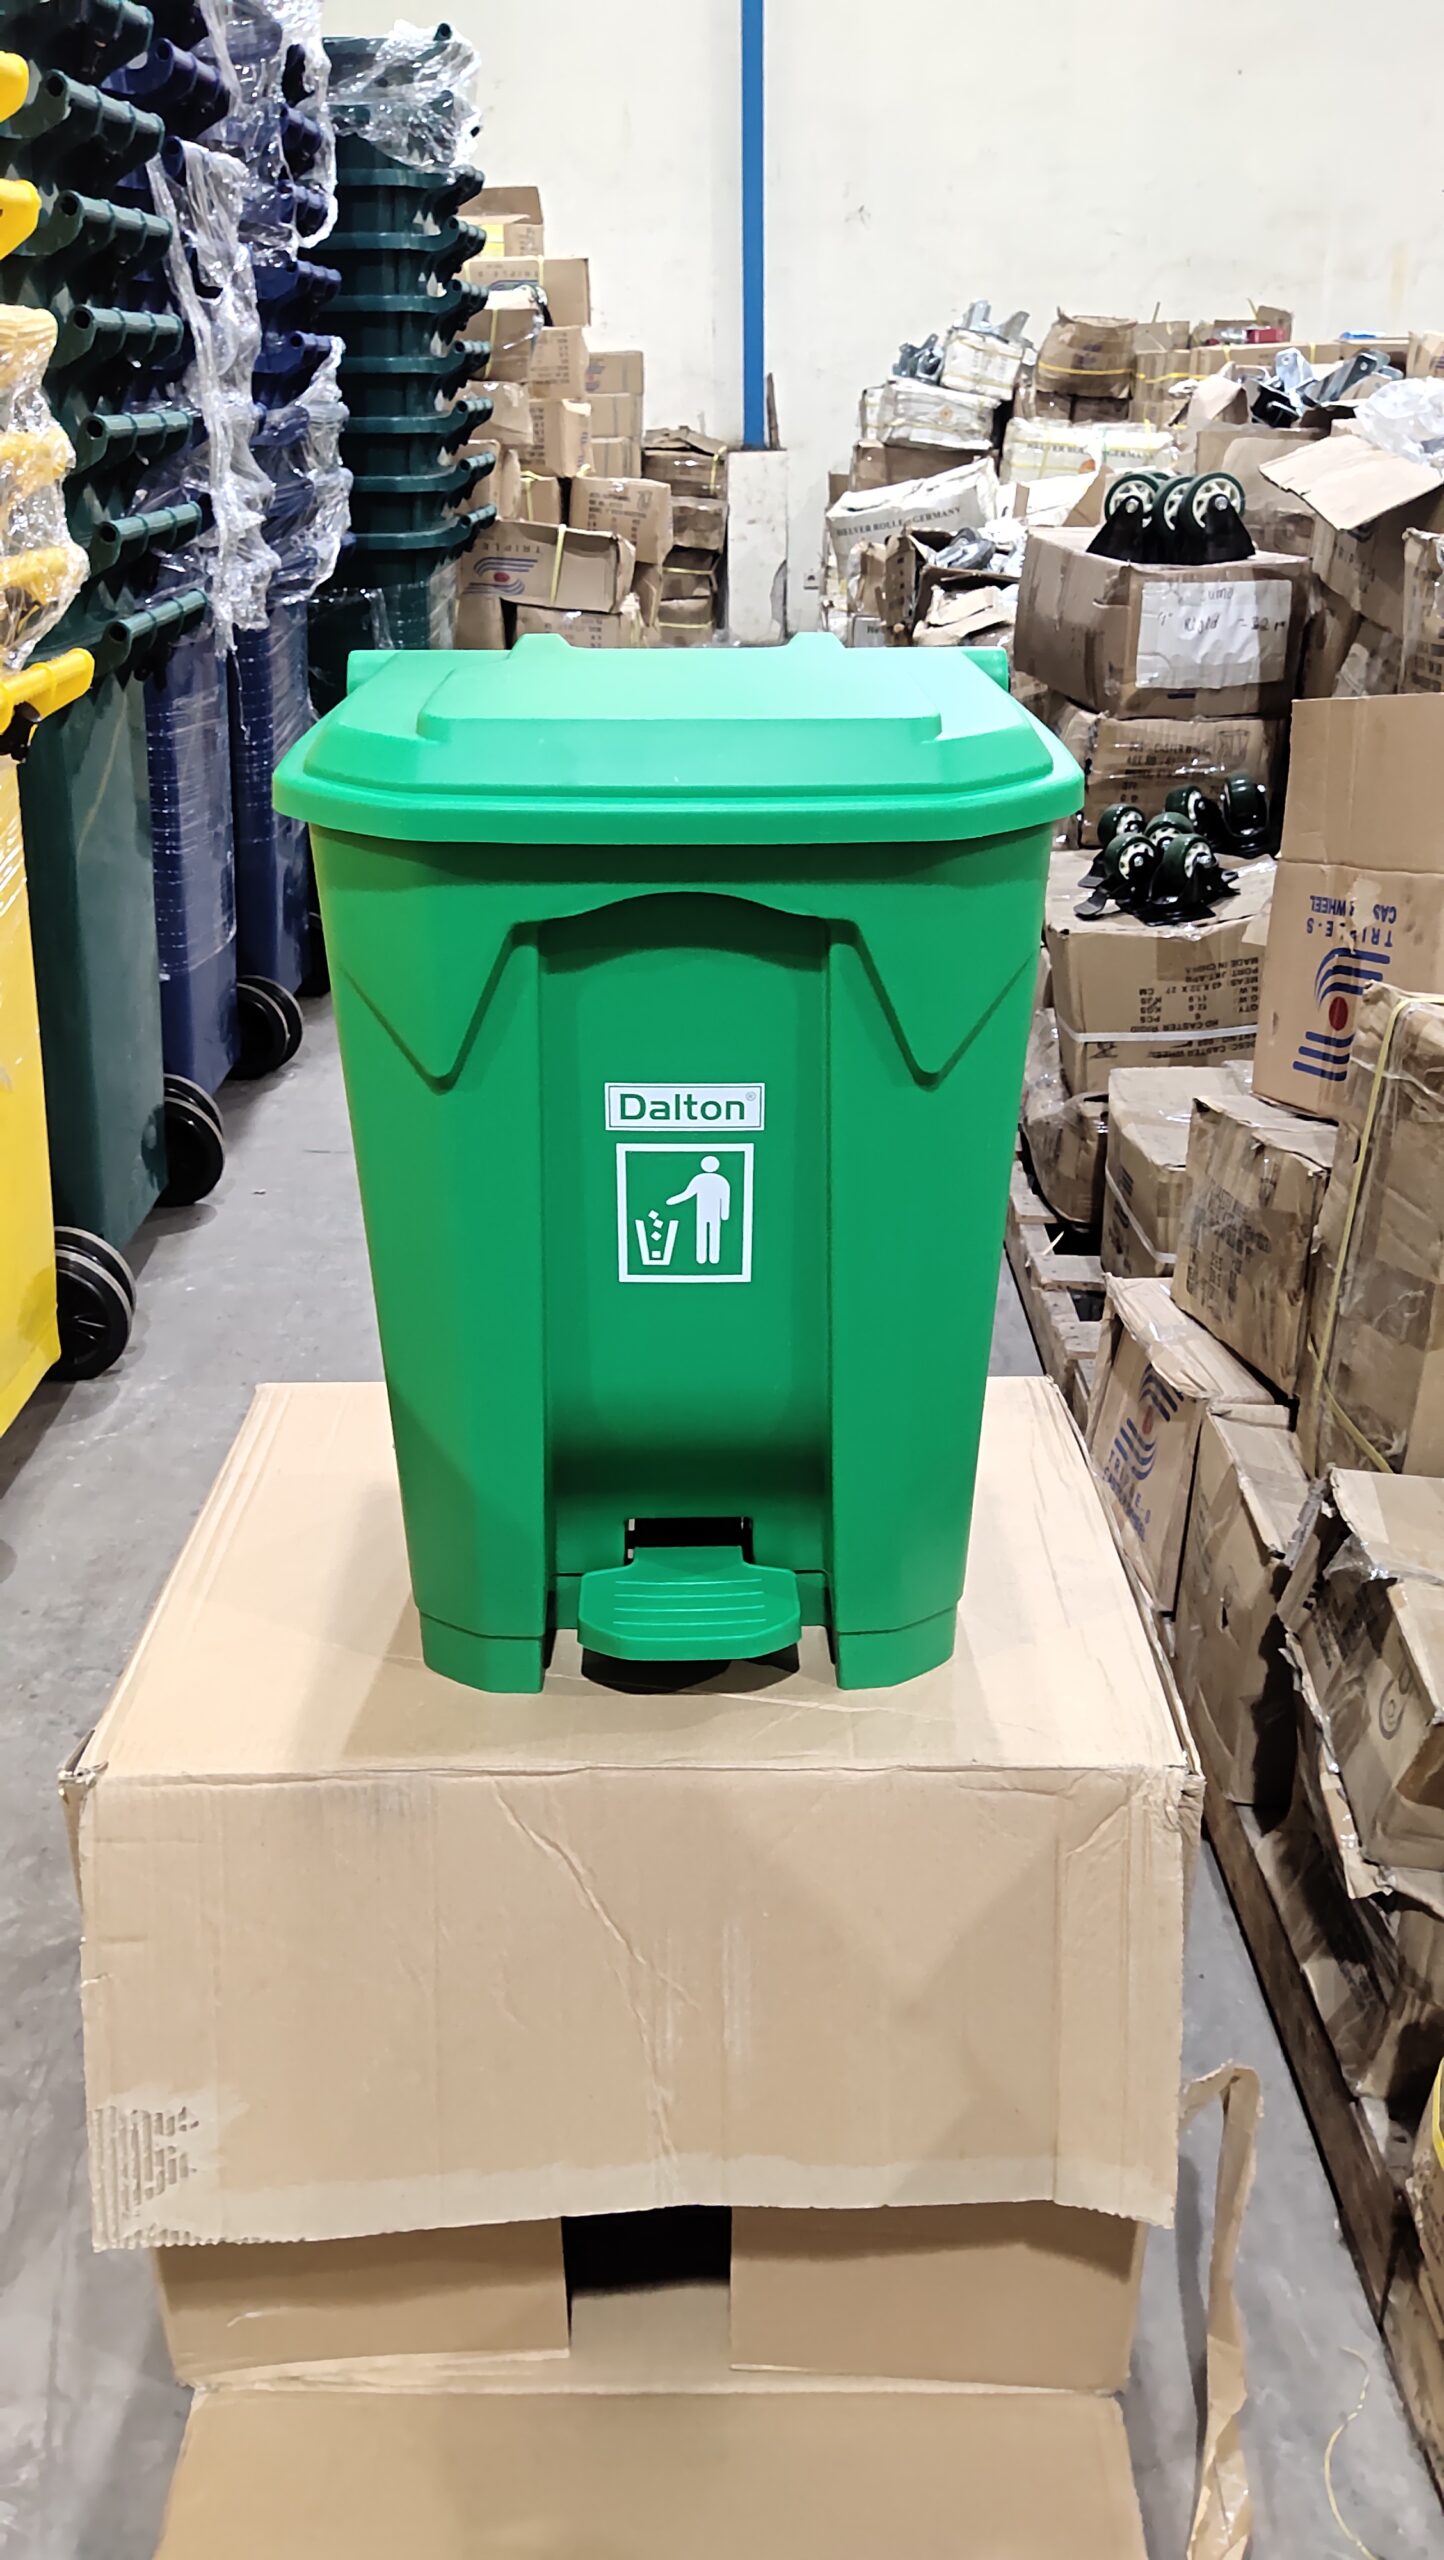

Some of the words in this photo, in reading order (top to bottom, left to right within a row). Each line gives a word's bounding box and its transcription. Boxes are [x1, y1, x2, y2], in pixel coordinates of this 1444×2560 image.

[912, 507, 961, 523] GERMANY
[1310, 895, 1346, 917] WHEEL
[1230, 957, 1258, 967] MADE
[1139, 988, 1155, 996] CM
[1139, 1015, 1160, 1023] PCS
[1162, 1021, 1204, 1032] CASTER
[1187, 1043, 1226, 1058] CASTER
[619, 1092, 746, 1121] Dalton
